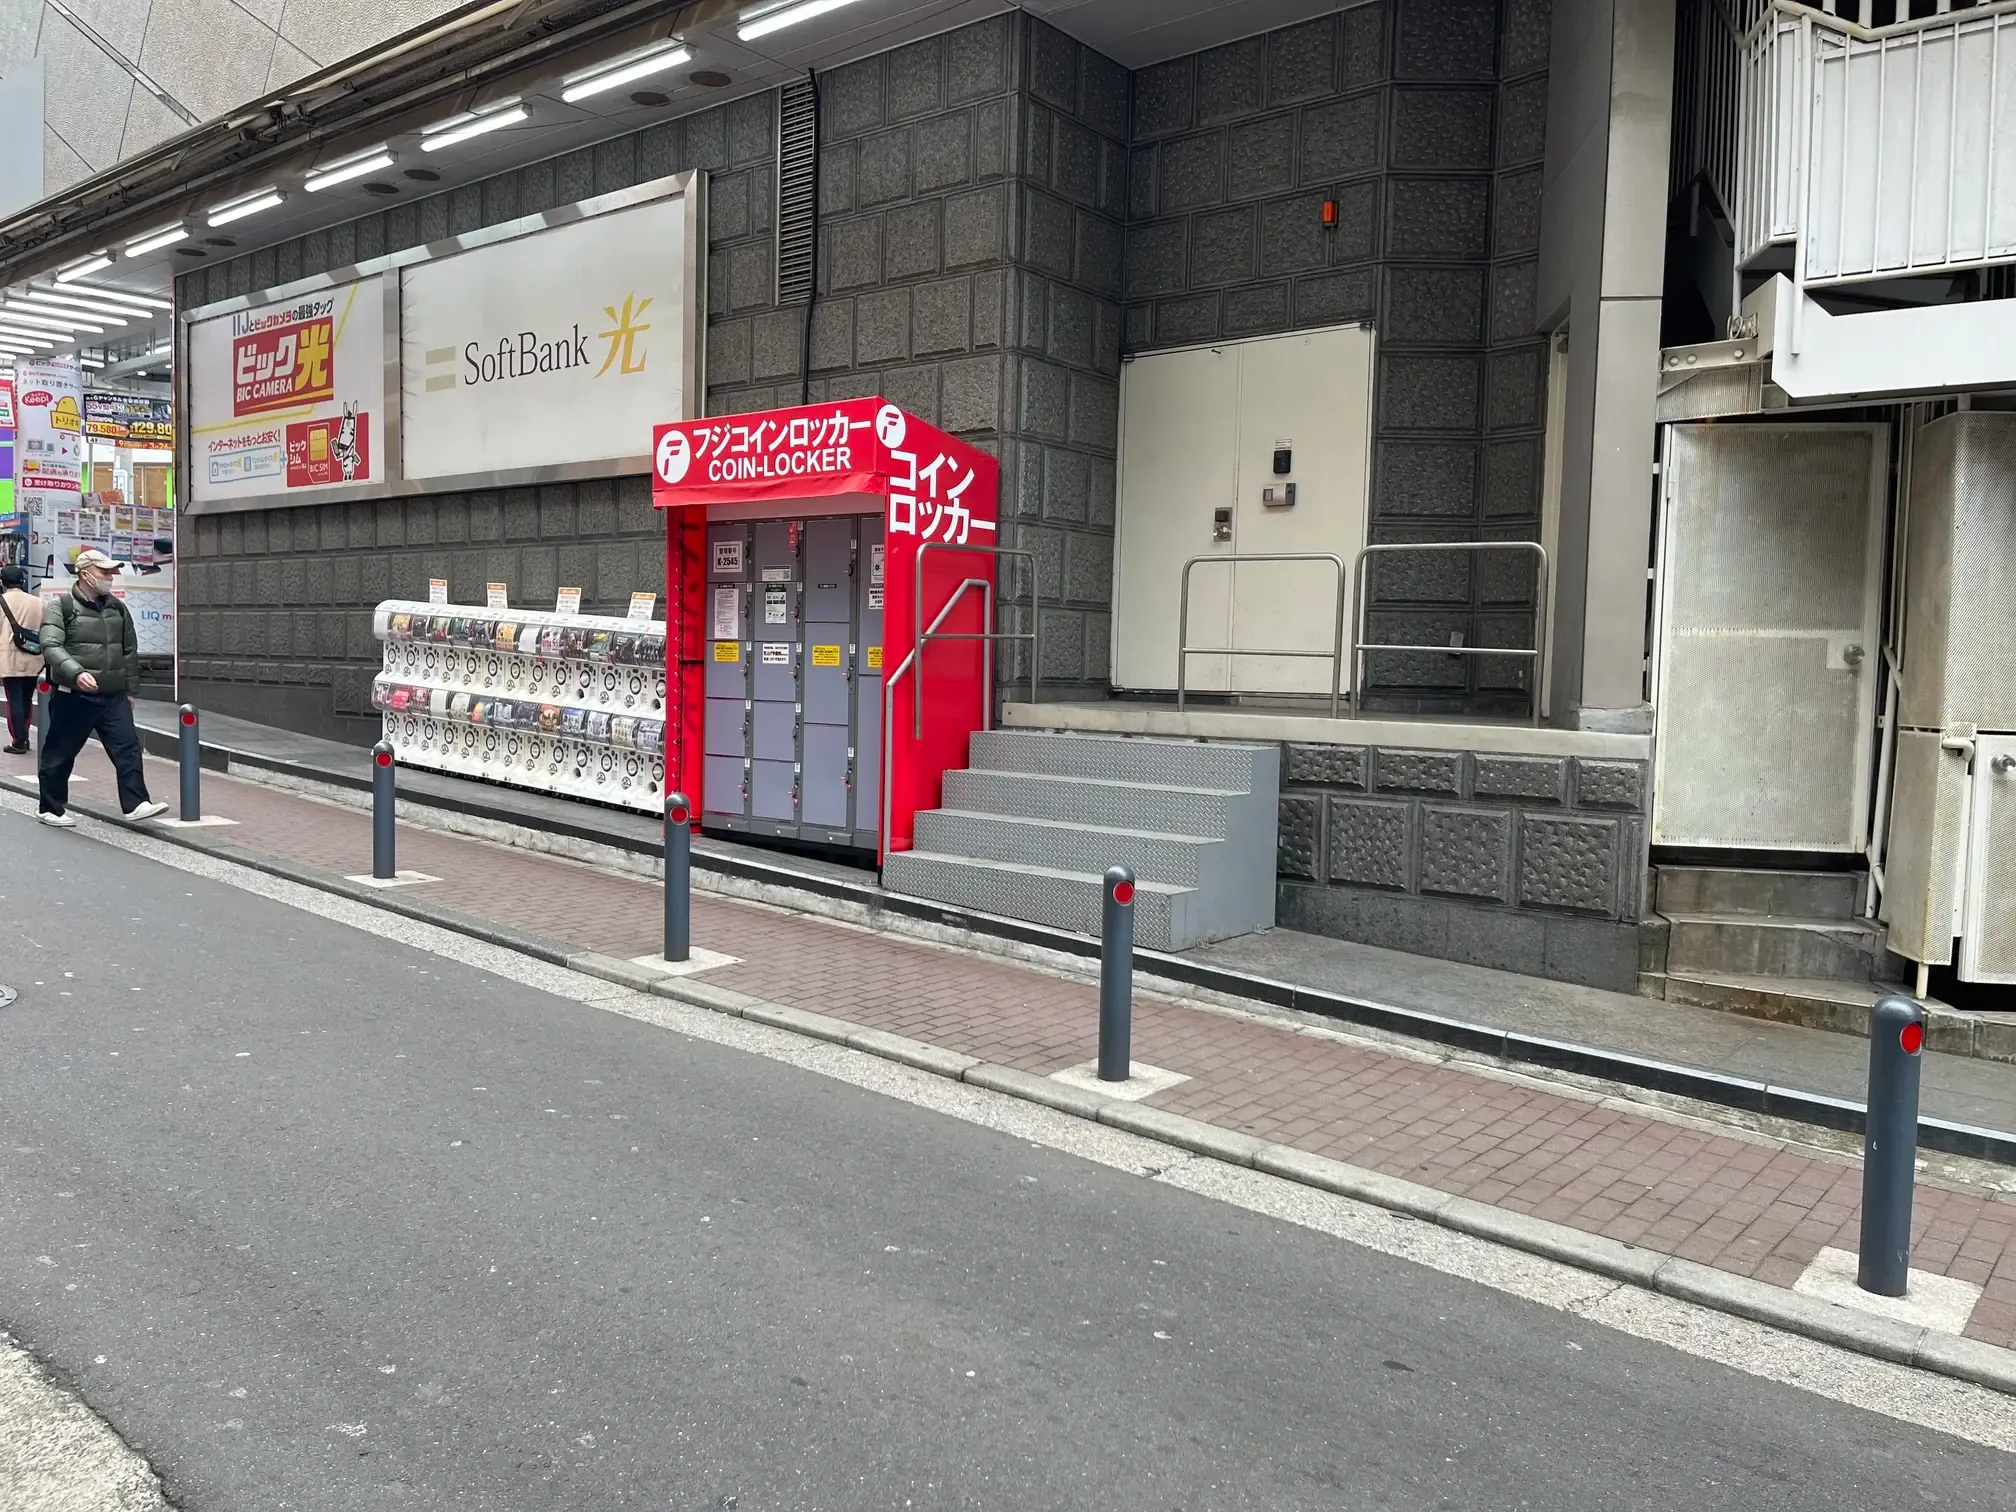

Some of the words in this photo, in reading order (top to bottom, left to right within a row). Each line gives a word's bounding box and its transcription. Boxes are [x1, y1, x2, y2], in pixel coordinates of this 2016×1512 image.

[464, 323, 590, 386] SoftBank
[593, 290, 655, 380] 光
[236, 387, 252, 402] BIC
[253, 377, 293, 399] CAMERA
[693, 409, 871, 459] フジコインロッカー
[310, 463, 318, 473] BIC
[319, 462, 328, 472] SIM
[708, 446, 852, 482] COIN-LOCKER
[890, 449, 976, 500] コイン
[889, 493, 996, 545] ロッカー
[717, 556, 738, 566] K-2545
[142, 610, 160, 622] UQ
